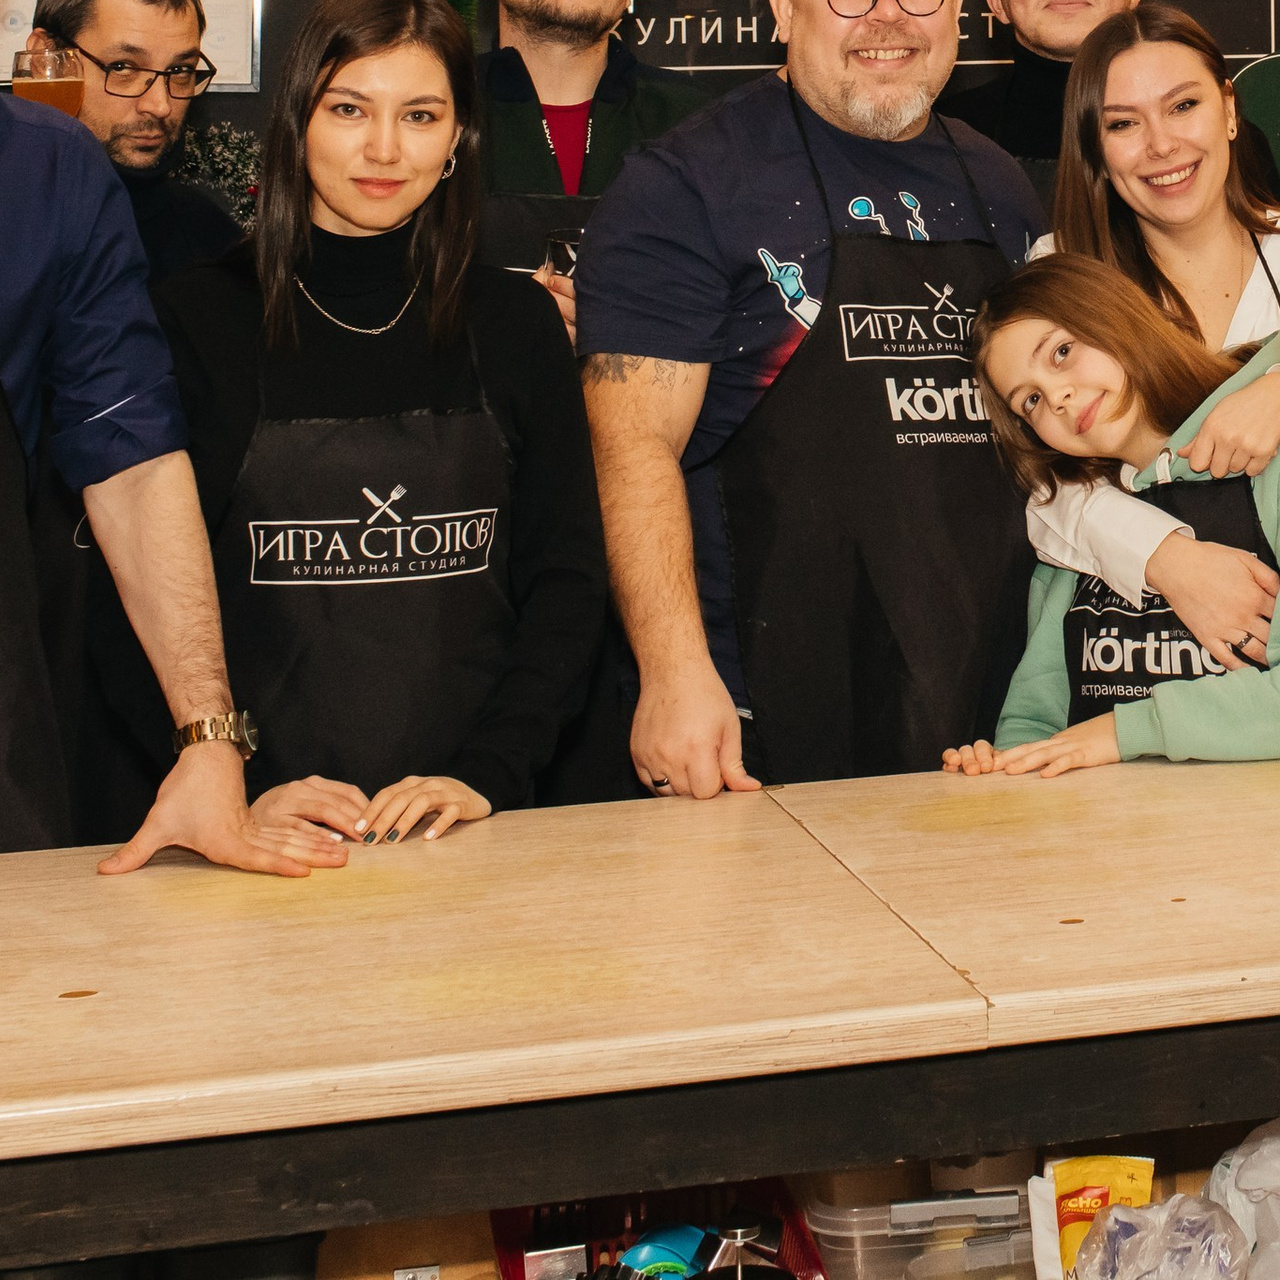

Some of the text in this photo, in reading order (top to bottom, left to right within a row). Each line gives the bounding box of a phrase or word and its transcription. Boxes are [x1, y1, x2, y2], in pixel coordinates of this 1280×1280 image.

[848, 311, 929, 340] ИГРА
[885, 377, 991, 421] körti
[896, 432, 988, 446] встраиваемая
[258, 517, 491, 561] ИГРА СТОЛОВ
[293, 555, 467, 576] КУЛИНАРНАЯ СТУДИЯ
[1081, 683, 1153, 698] встраиваем
